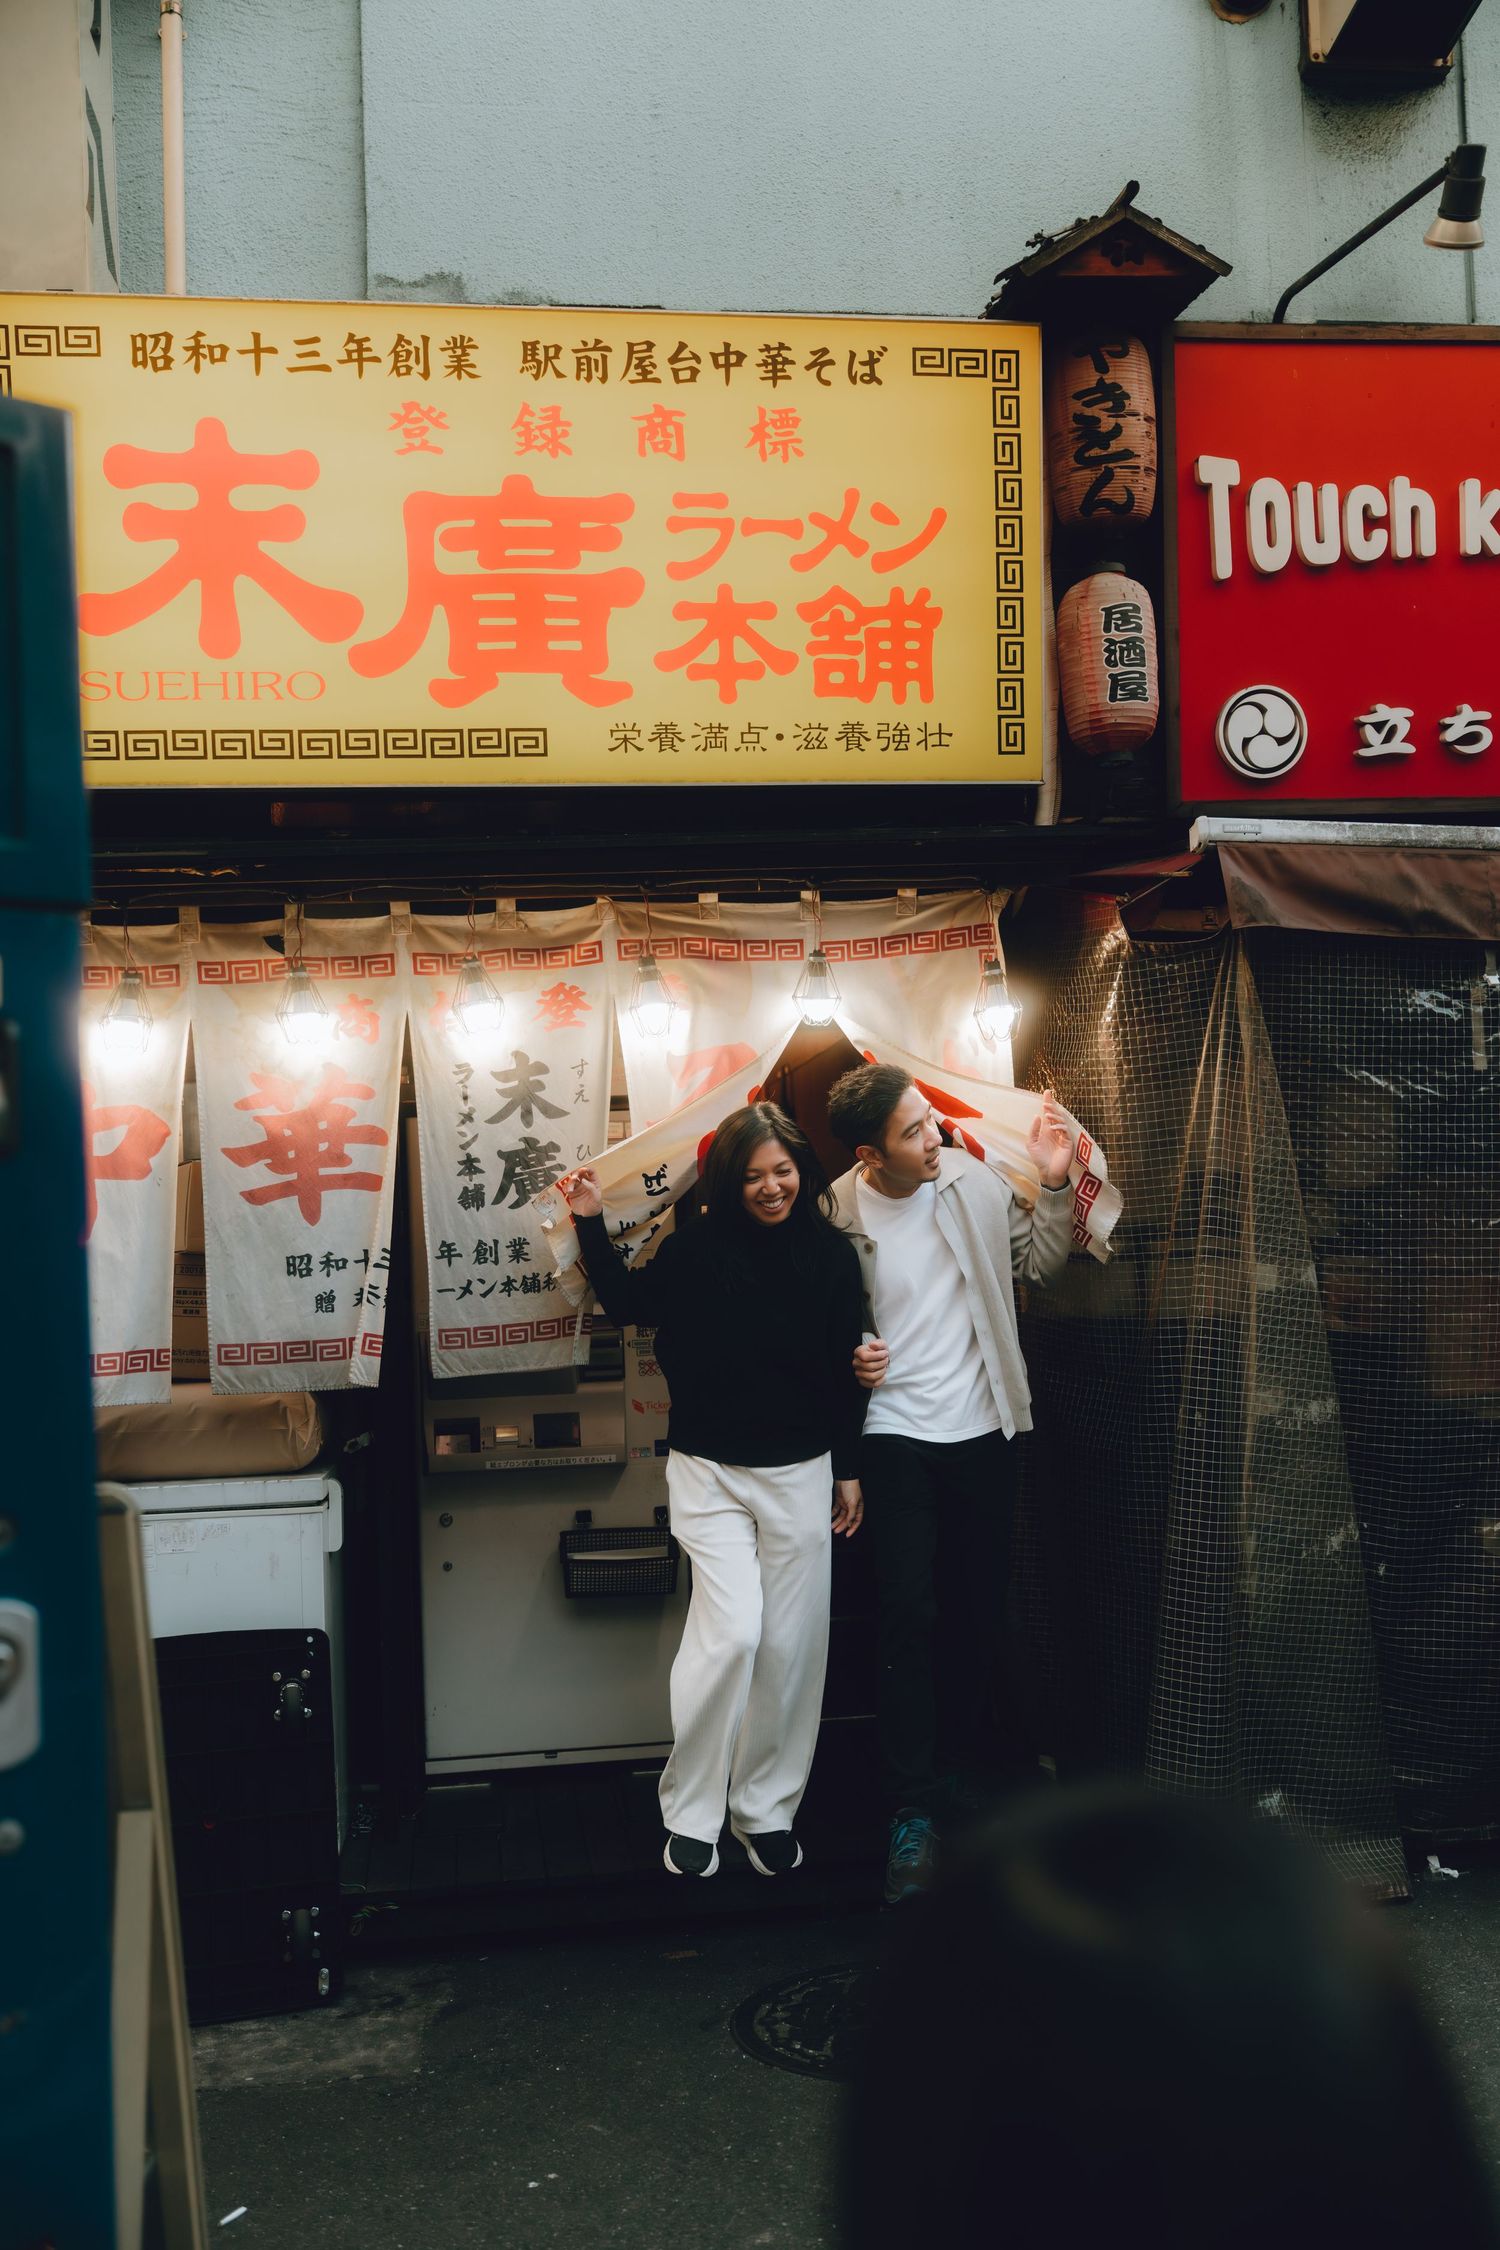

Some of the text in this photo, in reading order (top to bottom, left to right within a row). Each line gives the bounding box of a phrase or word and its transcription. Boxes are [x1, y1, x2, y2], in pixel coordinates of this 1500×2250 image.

[130, 331, 889, 387] 昭和十三年創業 駅前屋台中華そば
[388, 401, 805, 463] 登録商標
[666, 488, 947, 580] ラーメン
[1194, 454, 1438, 582] Touch
[78, 416, 645, 709] 末廣
[653, 583, 943, 706] 本舗
[1101, 602, 1149, 704] 居酒屋
[80, 671, 326, 701] SUEHIRO
[607, 720, 954, 753] 栄養満点・滋養強壮
[1353, 702, 1493, 758] 立ち
[452, 1062, 486, 1212] ラーメン本舗
[434, 1236, 532, 1268] 年創業
